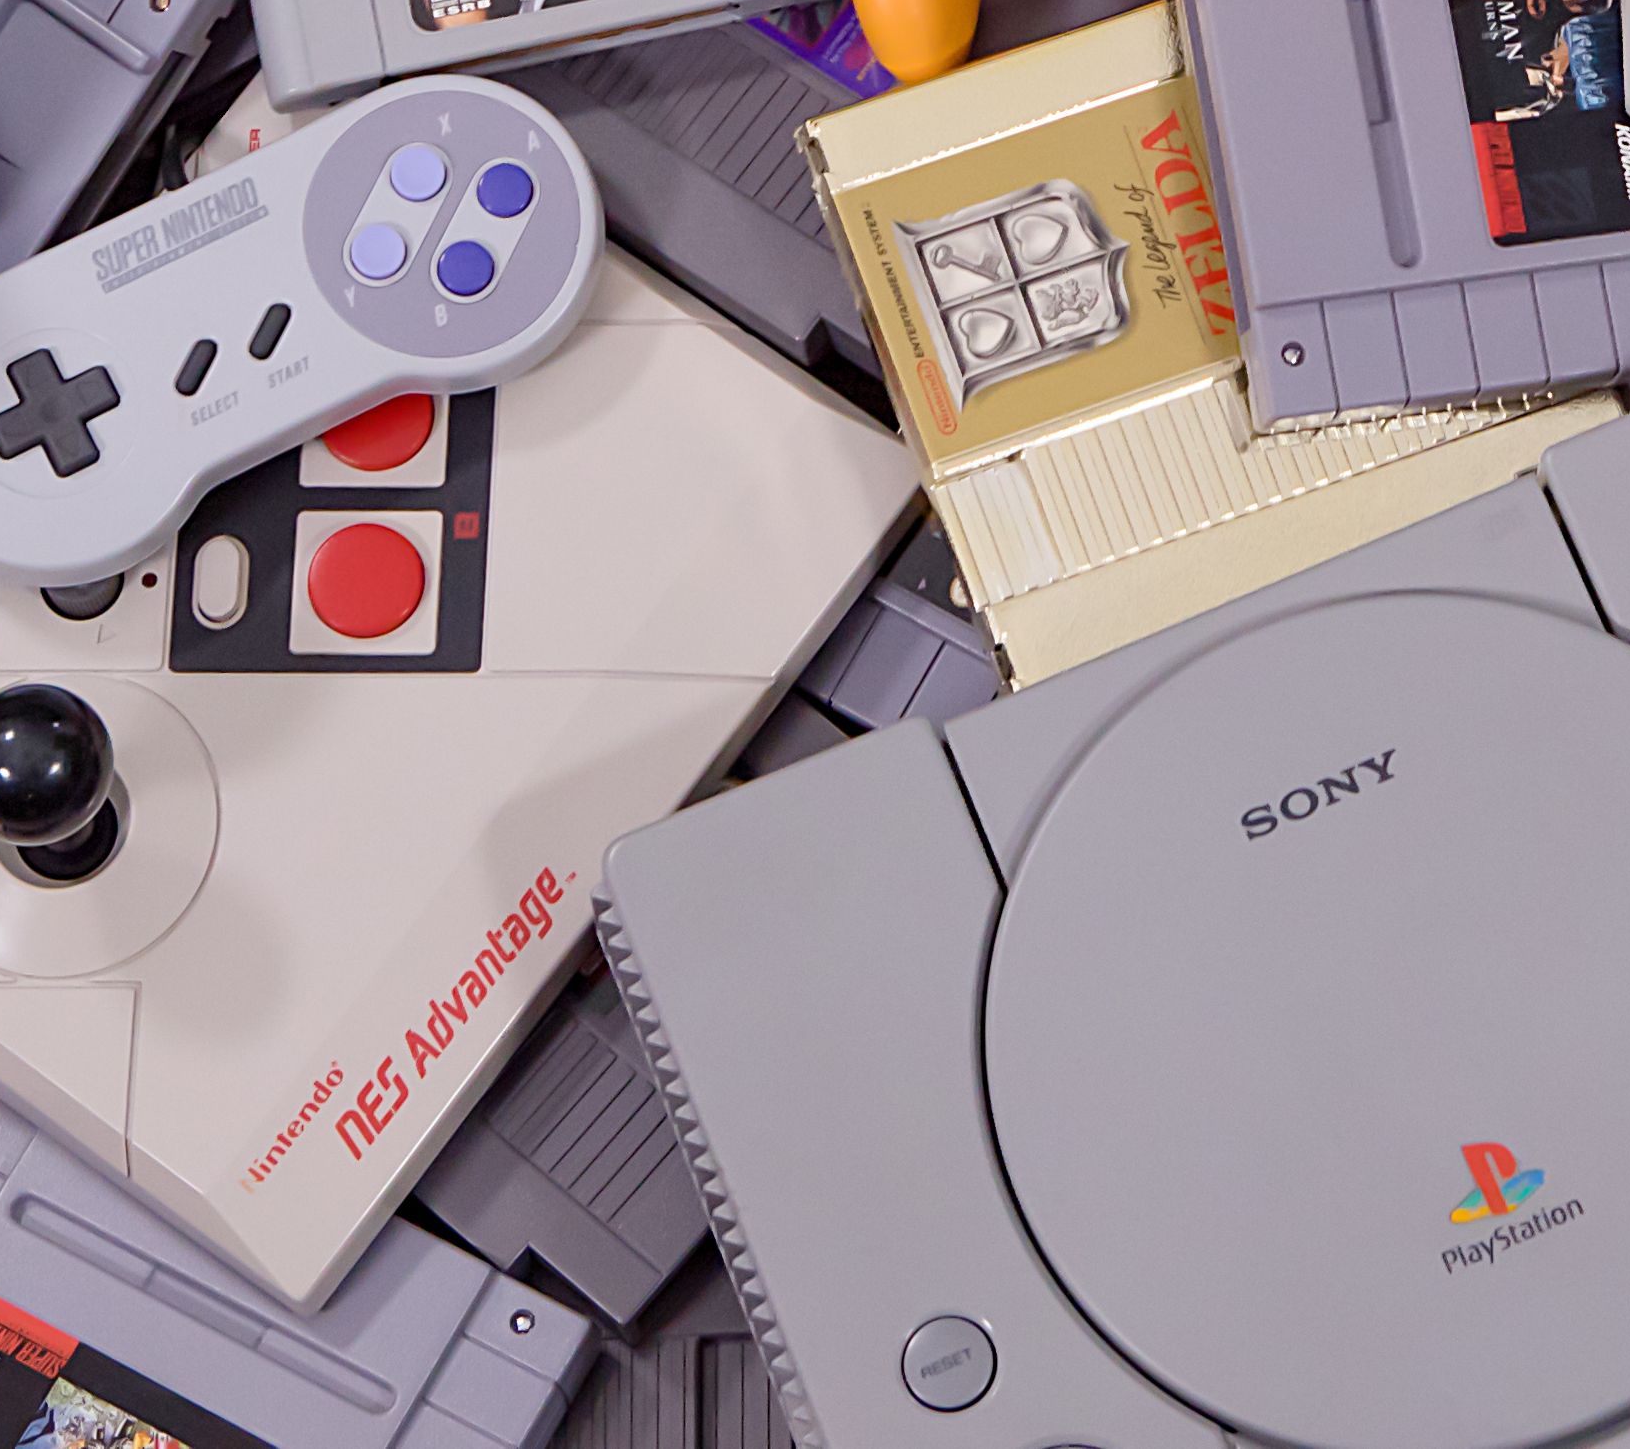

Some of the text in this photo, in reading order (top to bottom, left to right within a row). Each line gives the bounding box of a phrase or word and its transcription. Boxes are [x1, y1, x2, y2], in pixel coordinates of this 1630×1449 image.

[1241, 748, 1398, 840] SONY
[336, 867, 568, 1160] NES Advantage
[1441, 1200, 1584, 1272] PlayStation
